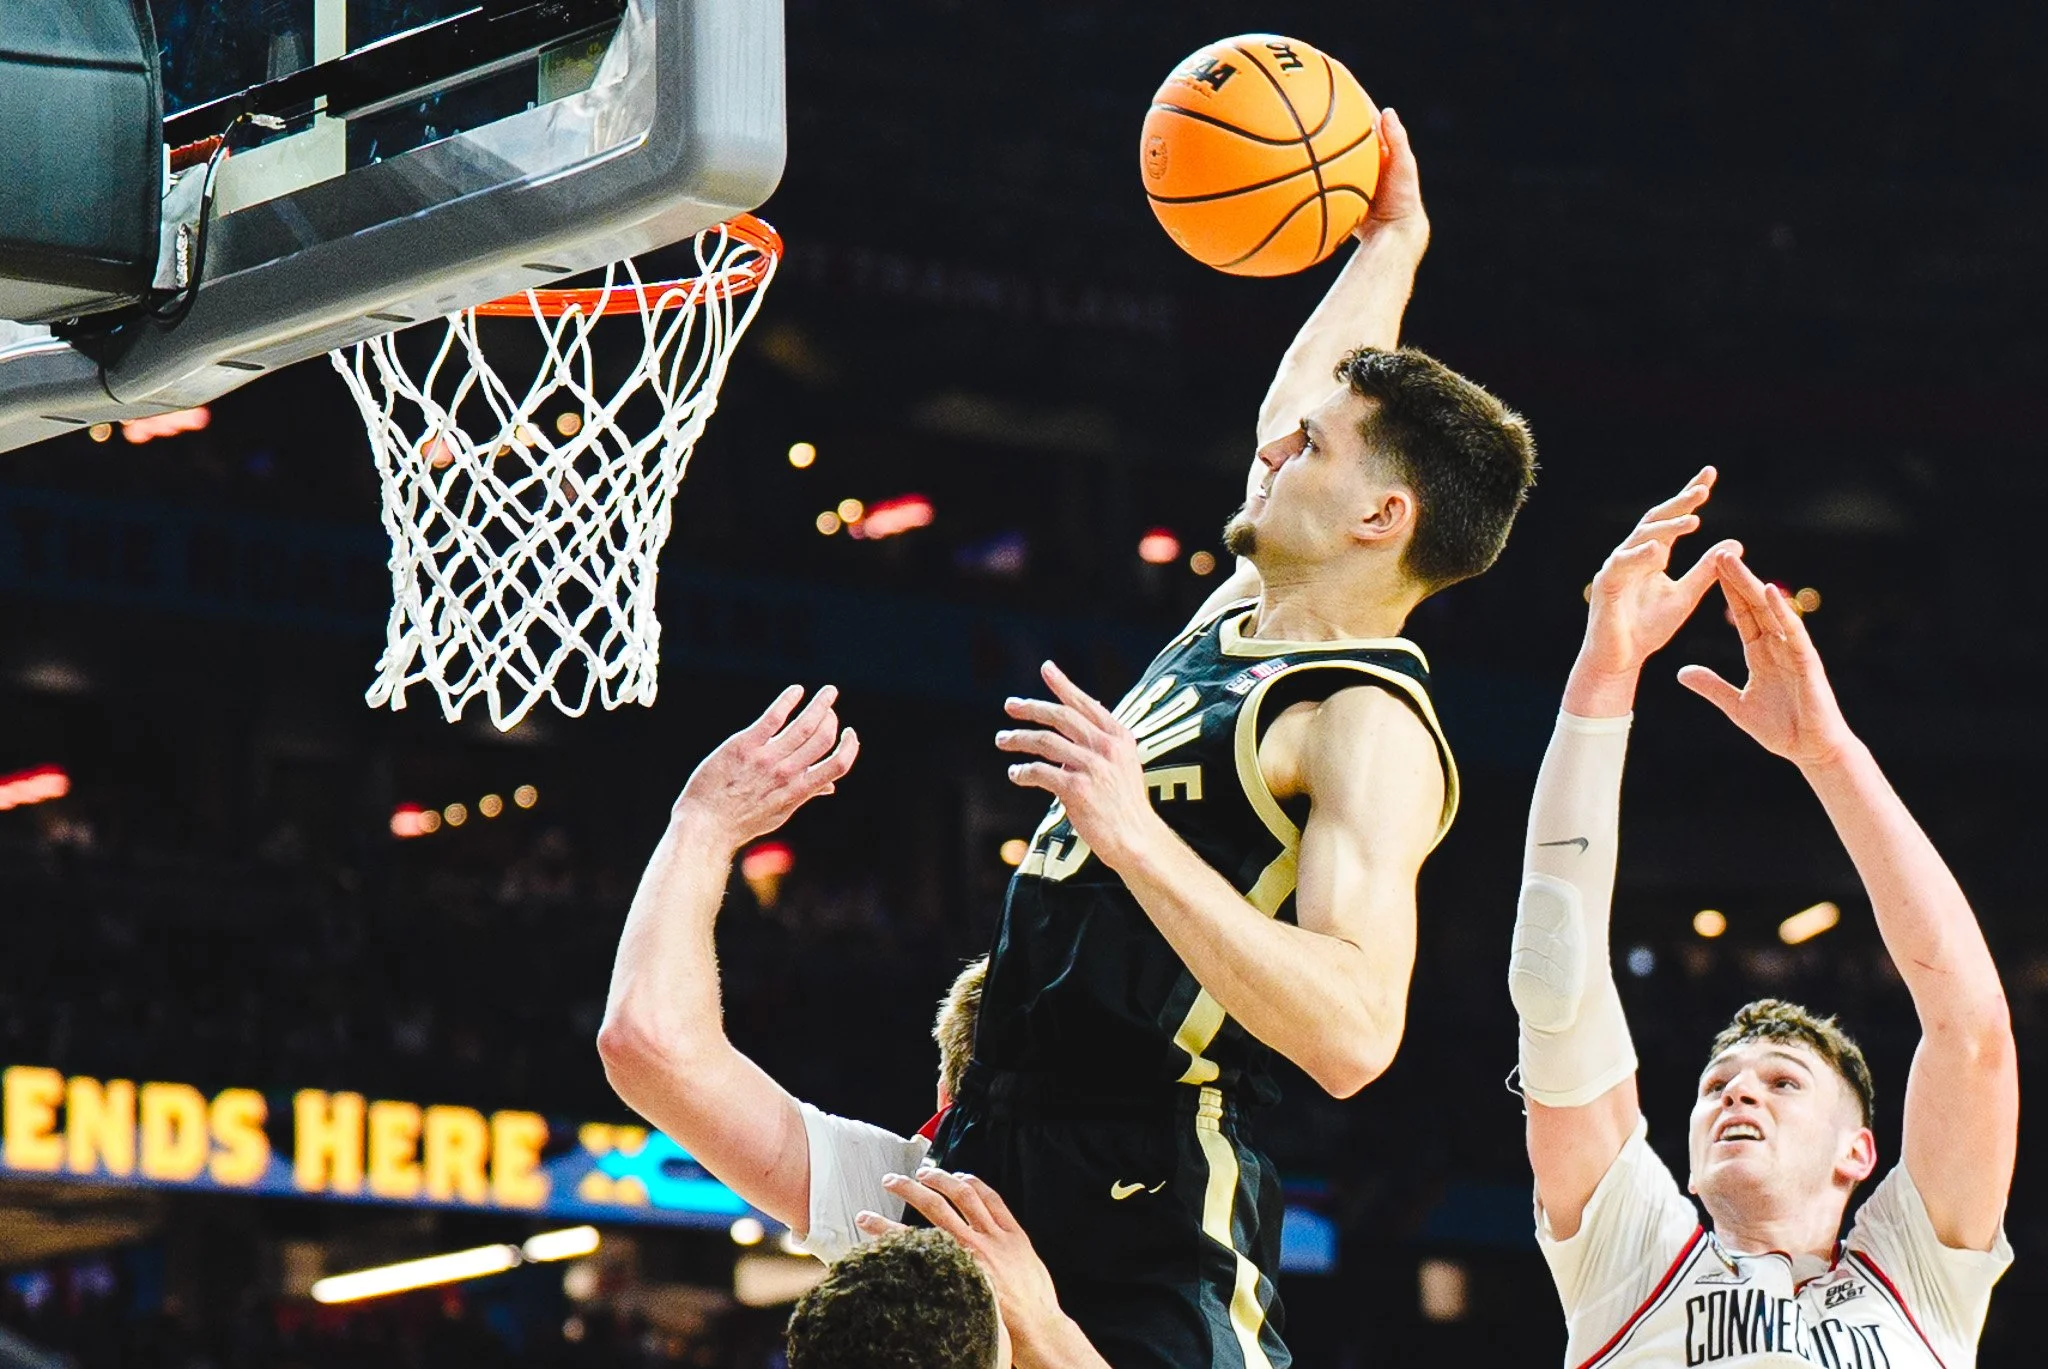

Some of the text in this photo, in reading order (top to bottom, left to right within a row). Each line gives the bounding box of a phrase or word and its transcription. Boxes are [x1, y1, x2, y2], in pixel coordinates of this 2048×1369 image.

[2, 1065, 551, 1209] ENDS HERE
[1826, 1279, 1854, 1297] BIG
